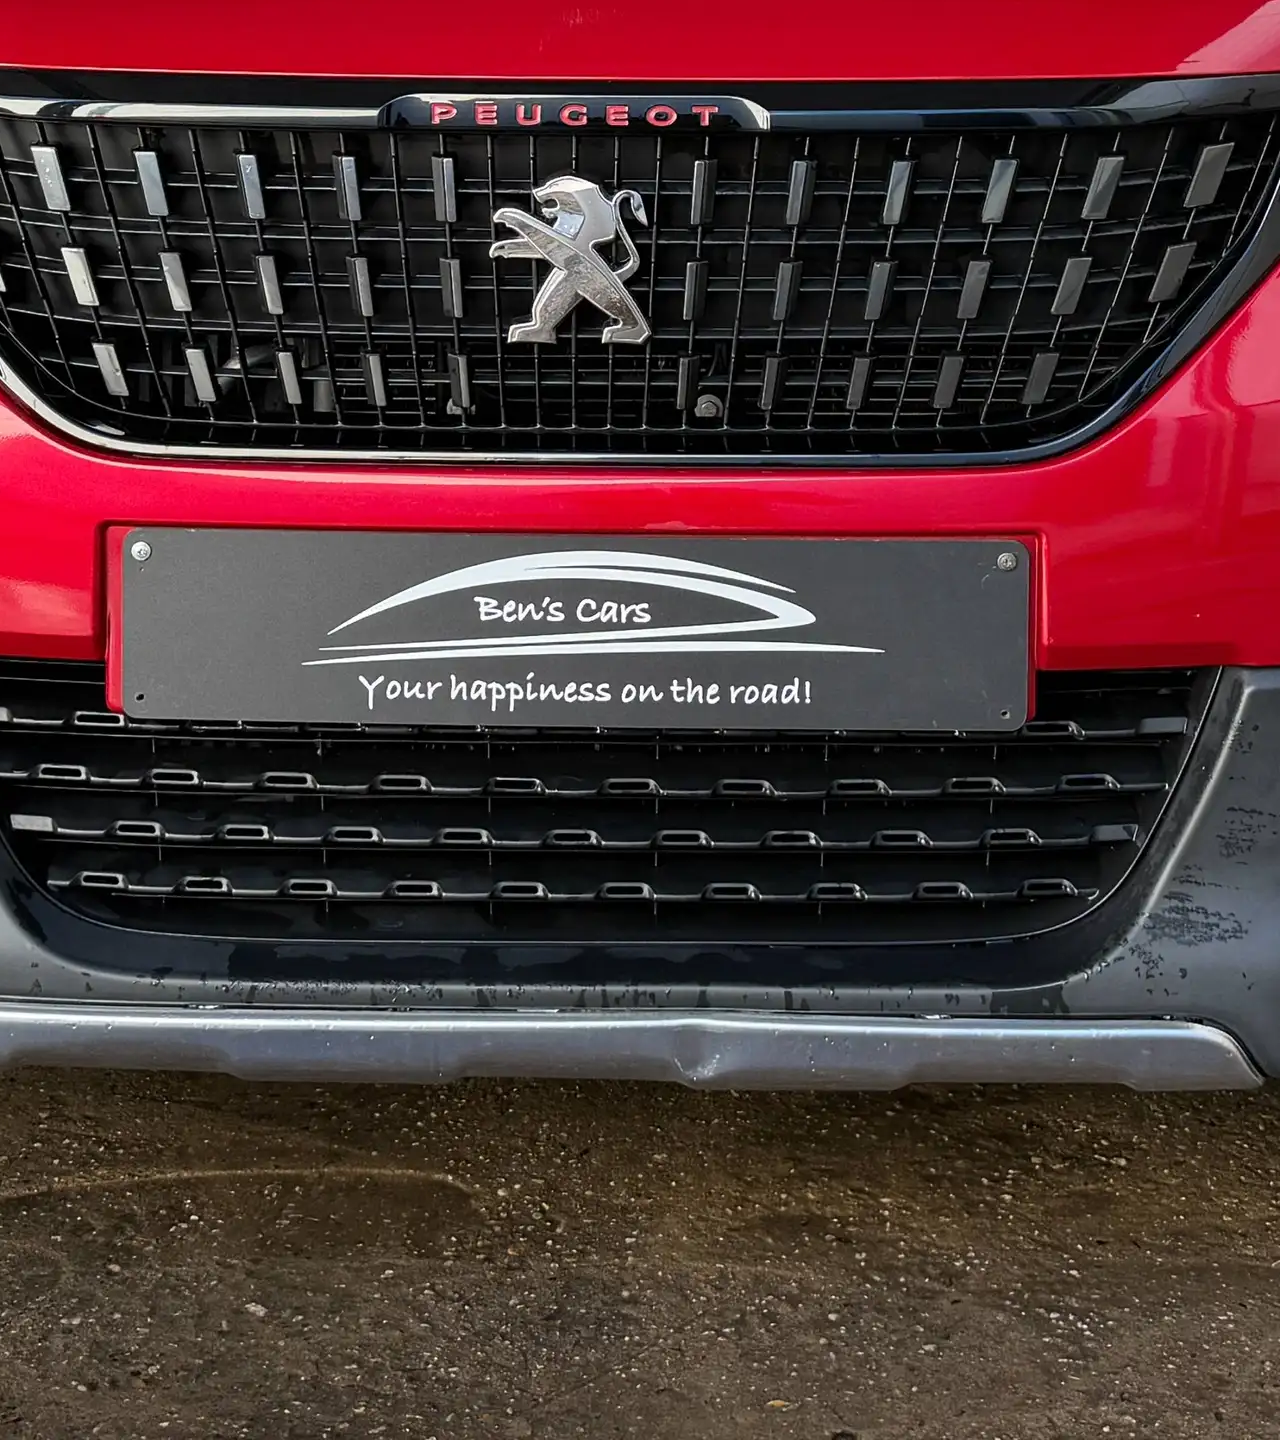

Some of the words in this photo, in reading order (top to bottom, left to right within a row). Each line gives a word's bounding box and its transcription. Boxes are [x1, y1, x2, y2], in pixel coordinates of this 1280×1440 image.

[431, 101, 719, 127] PEUGEOT
[473, 595, 566, 623] Ben's
[576, 597, 652, 624] Cars
[358, 674, 443, 711] Your
[450, 672, 612, 712] happiness
[621, 680, 664, 705] on
[670, 677, 721, 705] the
[729, 676, 813, 705] road!
